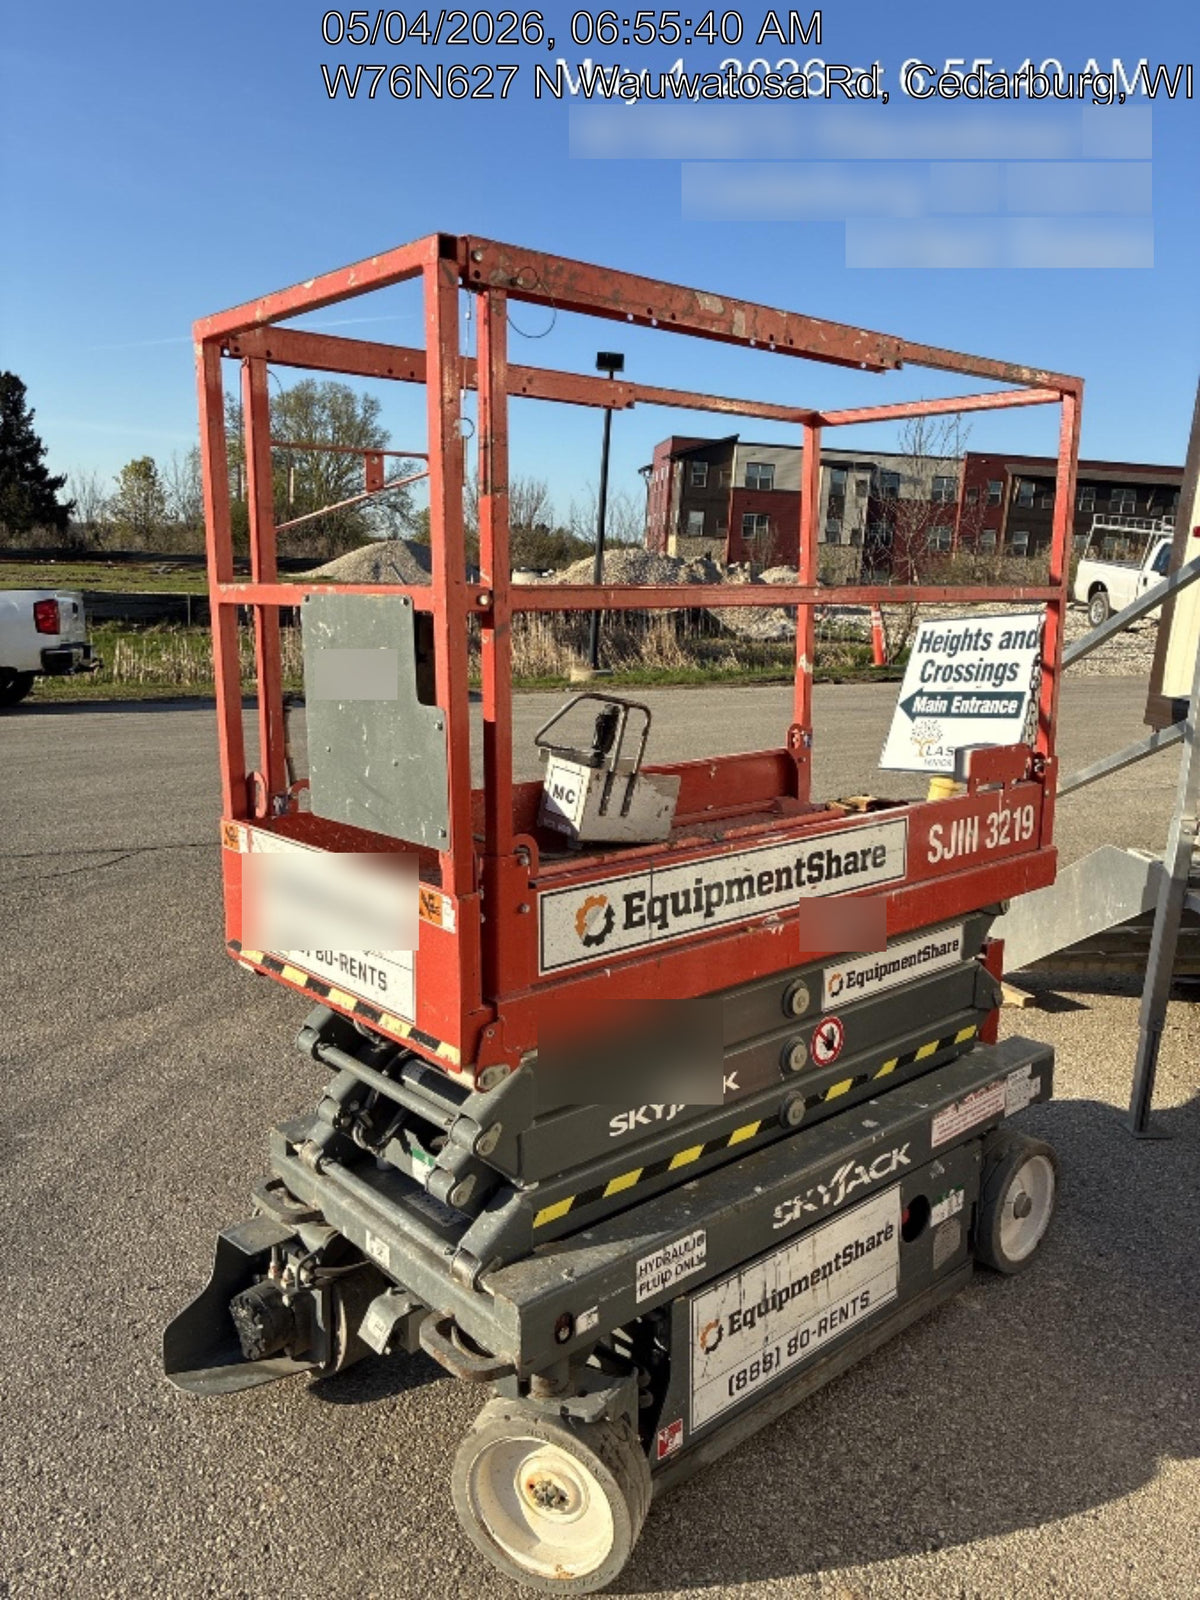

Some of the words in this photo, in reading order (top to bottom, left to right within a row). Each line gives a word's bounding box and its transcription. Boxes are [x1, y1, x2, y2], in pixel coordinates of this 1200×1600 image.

[917, 626, 994, 658] Heights
[998, 628, 1039, 651] and
[919, 657, 1020, 688] Crossings
[912, 696, 948, 714] Main
[950, 696, 1018, 714] Entrance
[926, 745, 955, 757] LAS
[552, 783, 576, 805] MC
[985, 804, 1034, 849] 3219
[623, 844, 887, 930] EquipmentShare
[846, 939, 960, 989] EquipmentShare
[772, 1142, 912, 1230] SKYJACK
[640, 1233, 705, 1277] HYDRAULIC
[639, 1268, 672, 1297] FLUID
[728, 1220, 894, 1337] EquipmentShare
[728, 1346, 781, 1397] (888)
[786, 1290, 871, 1358] 80-RENTS
